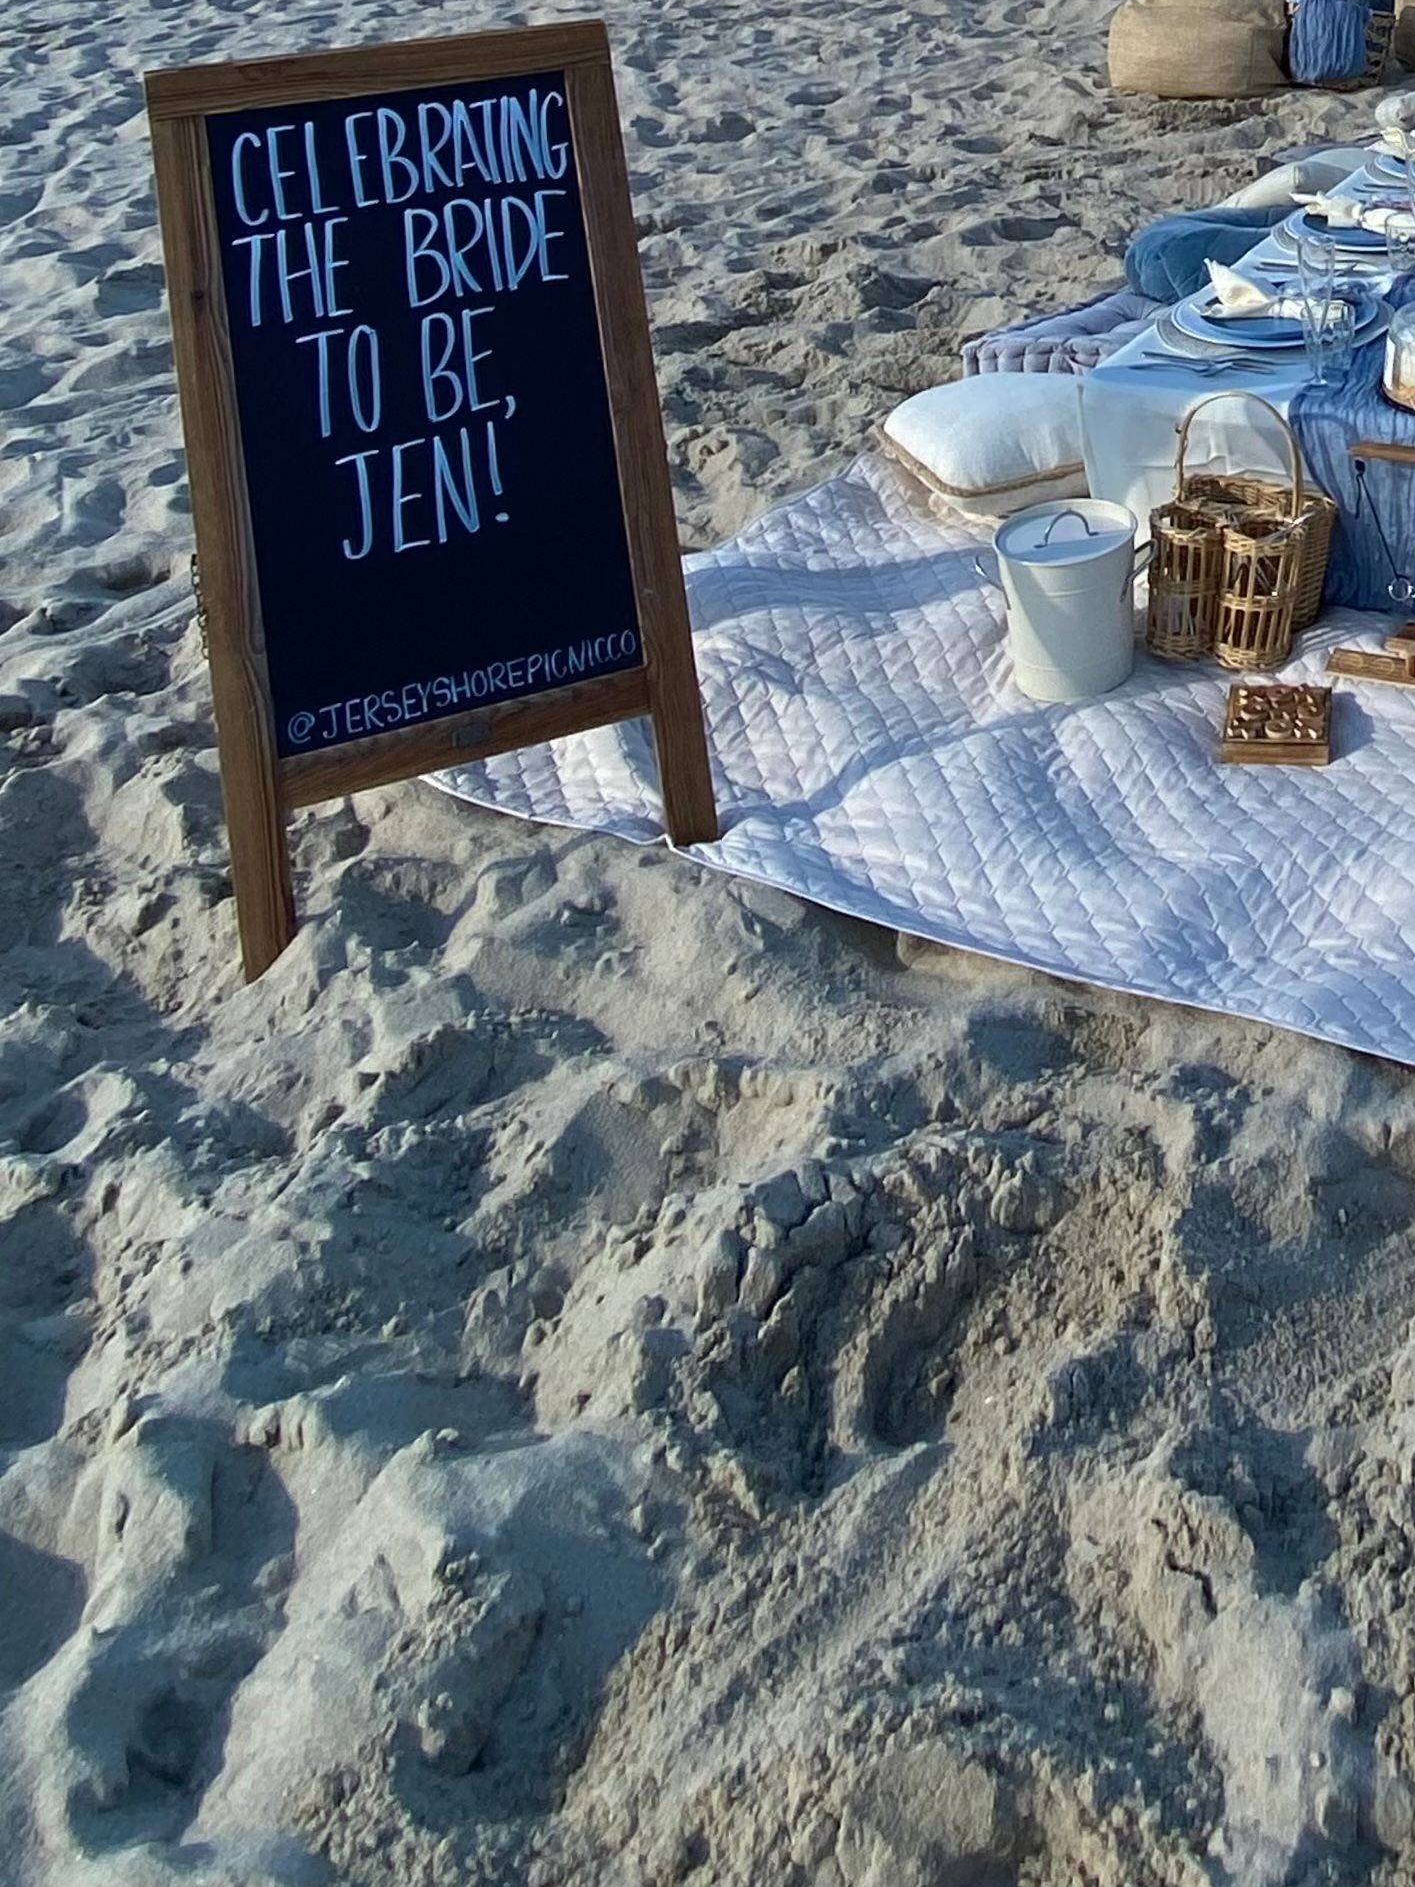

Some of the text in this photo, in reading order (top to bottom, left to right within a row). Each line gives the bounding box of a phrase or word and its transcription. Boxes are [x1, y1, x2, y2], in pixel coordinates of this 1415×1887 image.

[232, 89, 568, 226] CELEBRATING
[232, 190, 570, 327] THE BRIDE
[296, 306, 517, 438] TO BE,
[334, 420, 510, 560] JEN!
[287, 629, 637, 744] @JERSEYSHOREPICNICCO
